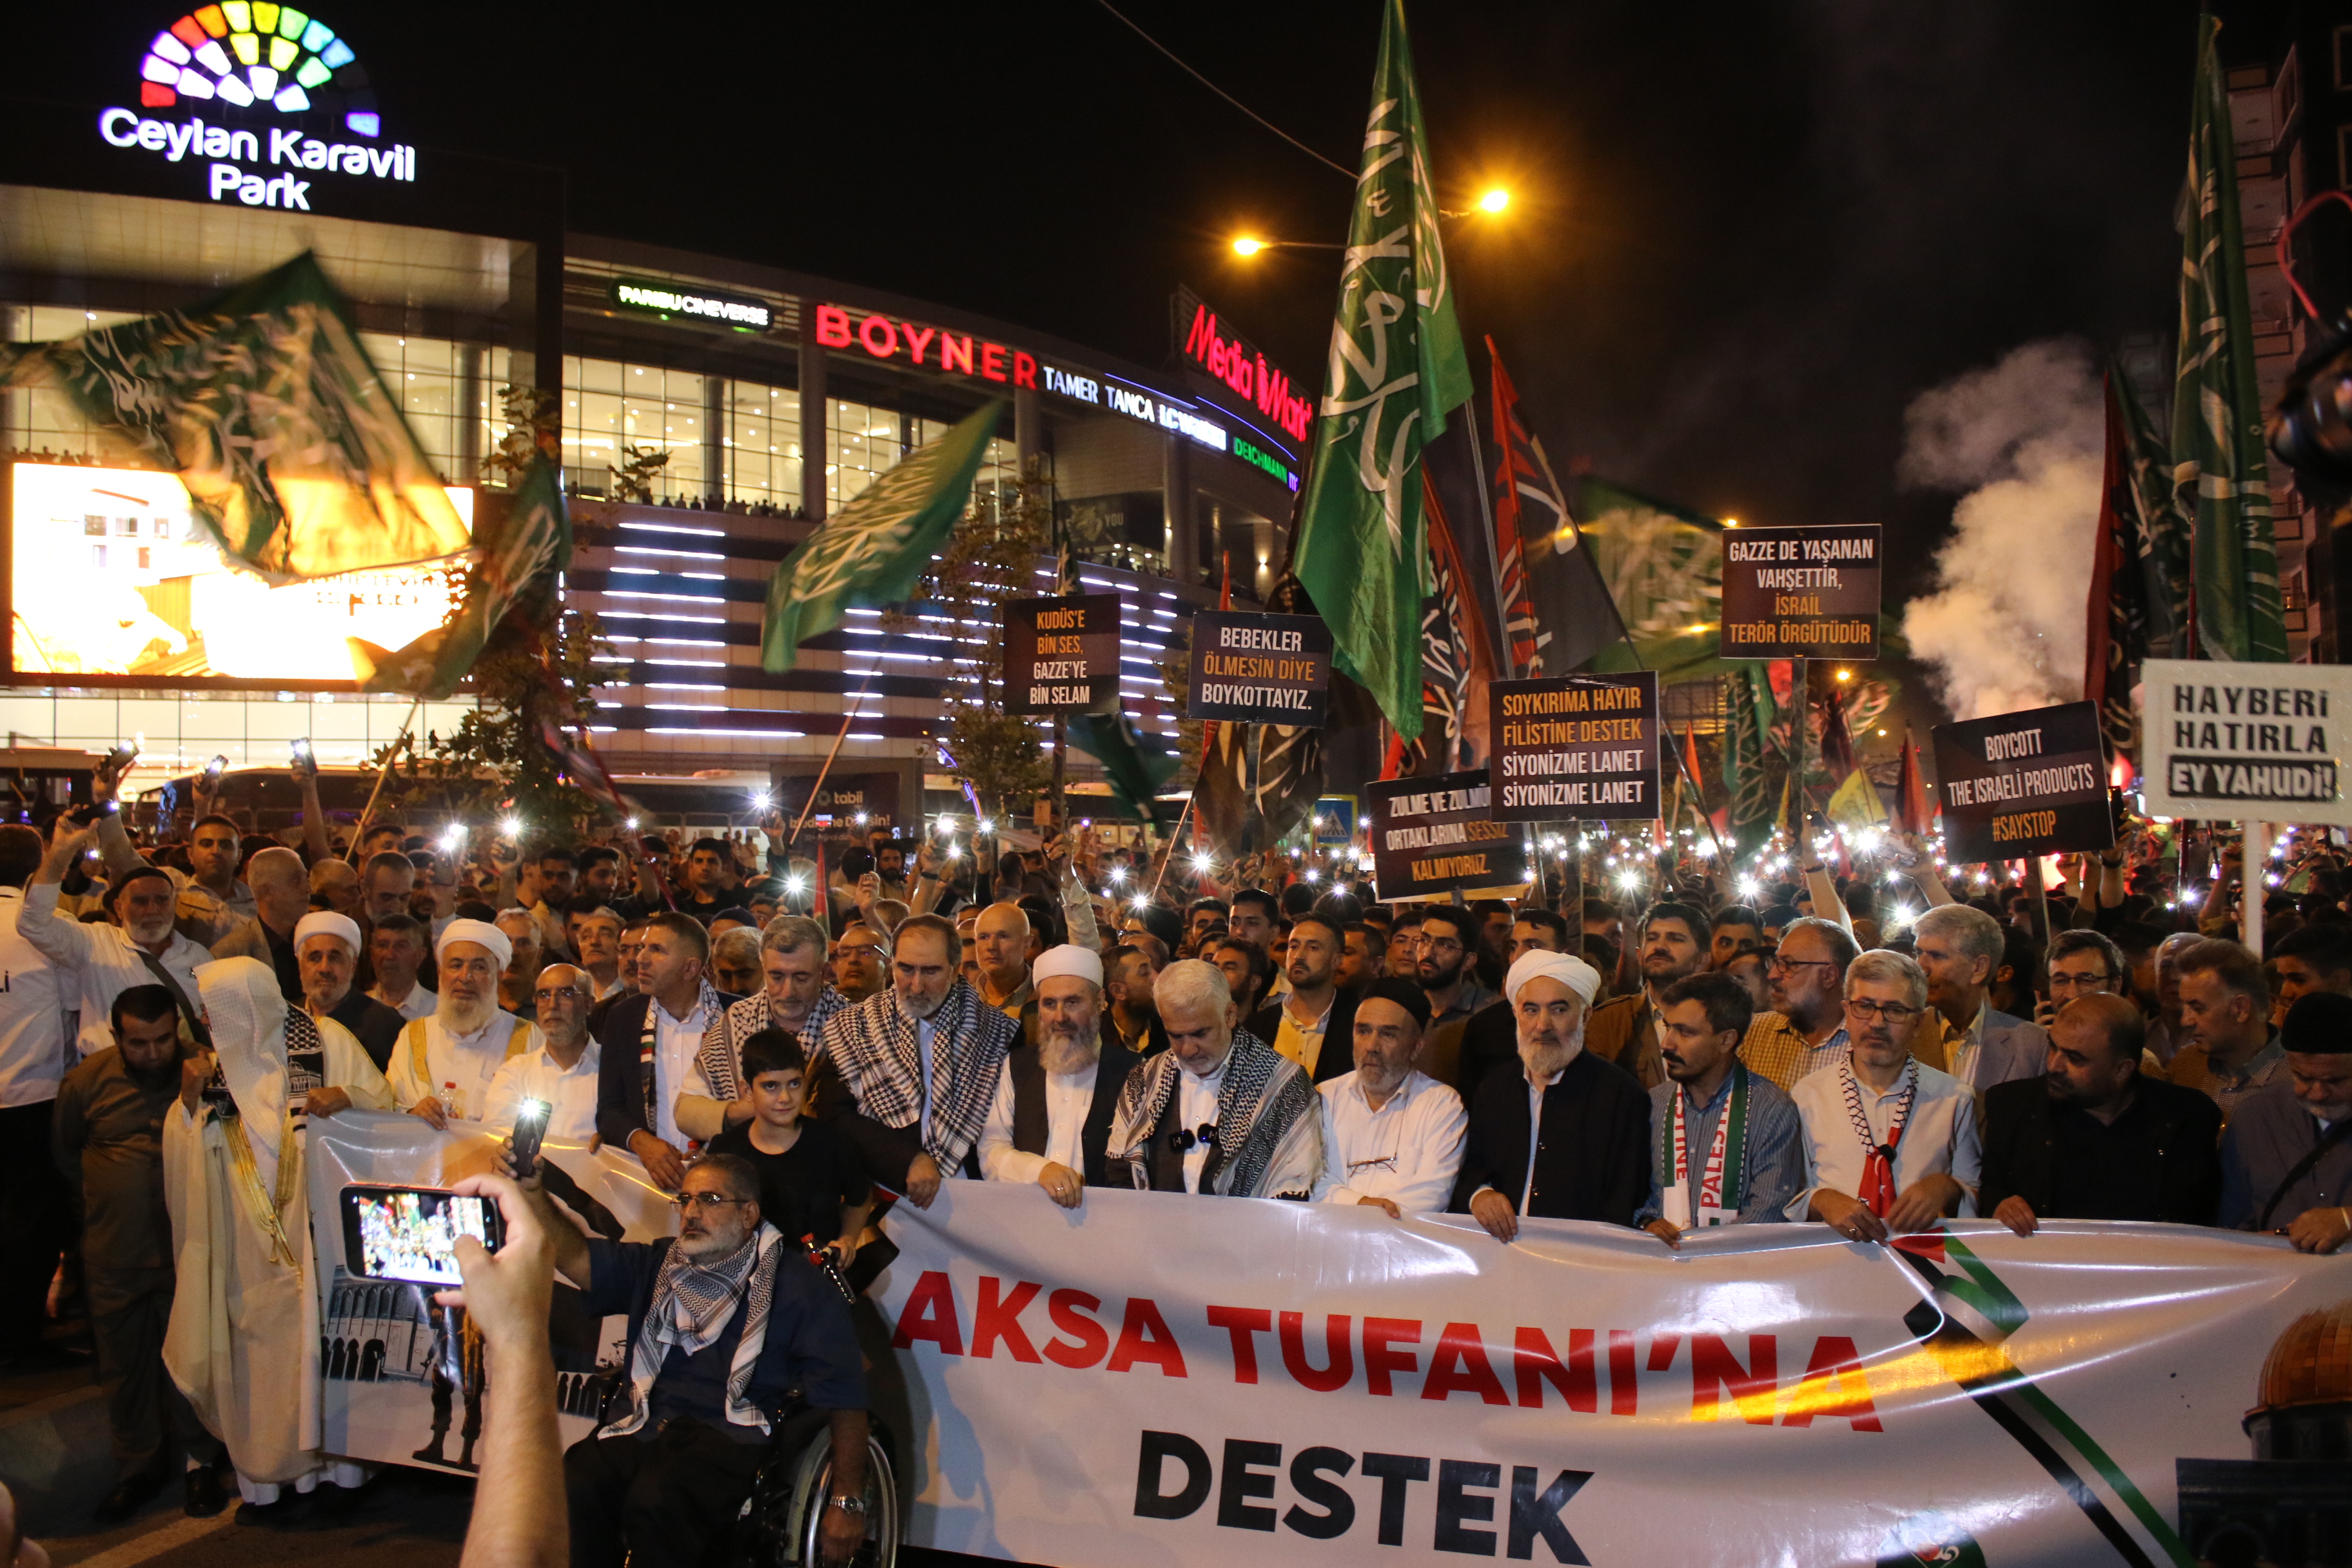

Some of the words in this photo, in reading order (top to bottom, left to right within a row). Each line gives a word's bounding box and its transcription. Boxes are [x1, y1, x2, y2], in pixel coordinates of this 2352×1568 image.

[99, 107, 259, 162] Ceylan
[270, 128, 416, 182] Karavil
[209, 162, 311, 211] Park
[816, 304, 1037, 391] BOYNER
[1185, 304, 1253, 401] Media
[1043, 366, 1099, 404] TAMER
[1104, 385, 1156, 423] TANCA
[1233, 436, 1288, 484] DEICHMANN
[1729, 541, 1776, 562] GAZZE
[1779, 540, 1799, 561] DE
[1802, 538, 1874, 564] YAŞANAN
[1756, 564, 1843, 592] VAHŞETTİR,
[1037, 607, 1085, 629] KUDÜS'E
[1775, 593, 1823, 616] İSRAİL
[1037, 633, 1056, 654] BİN
[1059, 635, 1084, 656] SES,
[1220, 627, 1302, 652] BEBEKLER
[1729, 620, 1777, 643] TERÖR
[1779, 620, 1871, 643] ÖRGÜTÜDÜR
[1033, 660, 1088, 680] GAZZE'YE
[1204, 651, 1275, 679] ÖLMESİN
[1278, 656, 1316, 681] DİYE
[1030, 683, 1049, 704] BİN
[1051, 685, 1090, 704] SELAM
[1201, 683, 1312, 710] BOYKOTTAYIZ.
[1502, 690, 1590, 716] SOYKIRIMA
[1592, 687, 1642, 711] HAYIR
[1503, 719, 1576, 747] FİLİSTİNE
[1580, 718, 1643, 742] DESTEK
[1984, 728, 2043, 761] BOYCOTT
[2173, 720, 2328, 754] HATIRLA
[1503, 749, 1588, 777] SİYONİZME
[1591, 749, 1644, 772] LANET
[1947, 780, 1974, 807] THE
[2023, 763, 2095, 797] PRODUCTS
[2171, 762, 2208, 794] EY
[834, 790, 864, 805] tabii
[1503, 779, 1589, 807] SİYONİZME
[1592, 781, 1645, 803] LANET
[1386, 822, 1468, 851] ORTAKLARINA
[1992, 810, 2057, 842] #SAYSTOP
[890, 1270, 1189, 1379] AKSA
[1206, 1304, 1884, 1433] TUFANI'NA
[1133, 1429, 1595, 1567] DESTEK
